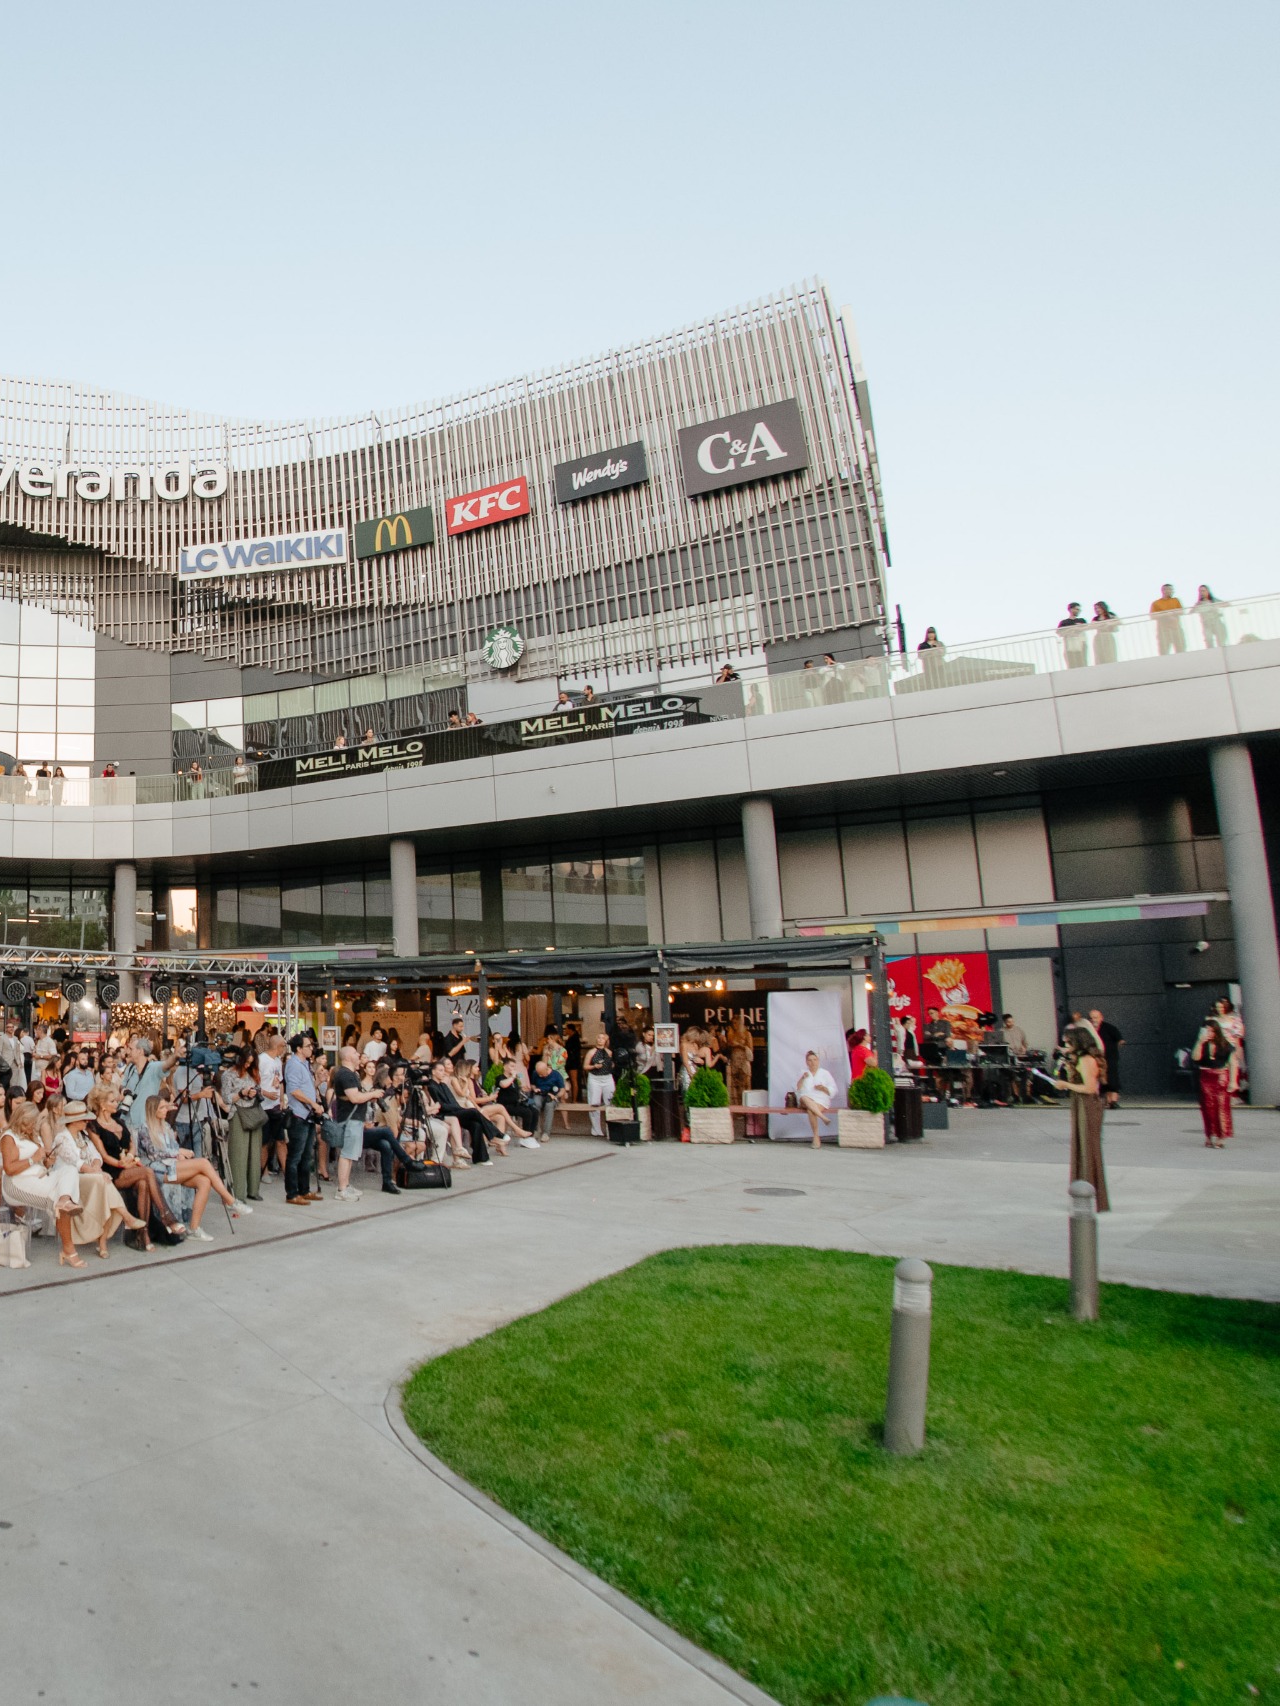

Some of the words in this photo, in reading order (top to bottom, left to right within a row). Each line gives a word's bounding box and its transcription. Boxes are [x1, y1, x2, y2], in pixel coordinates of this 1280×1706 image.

[697, 421, 788, 475] C&A
[571, 458, 629, 491] Wendy's
[450, 485, 521, 528] KFC
[180, 548, 219, 574] LC
[521, 712, 587, 735] MELI
[601, 698, 684, 721] MELO
[584, 721, 615, 732] PARIS
[663, 719, 684, 731] 1998
[296, 754, 347, 772] MELI
[358, 741, 424, 762] MELO
[345, 761, 370, 771] PARIS
